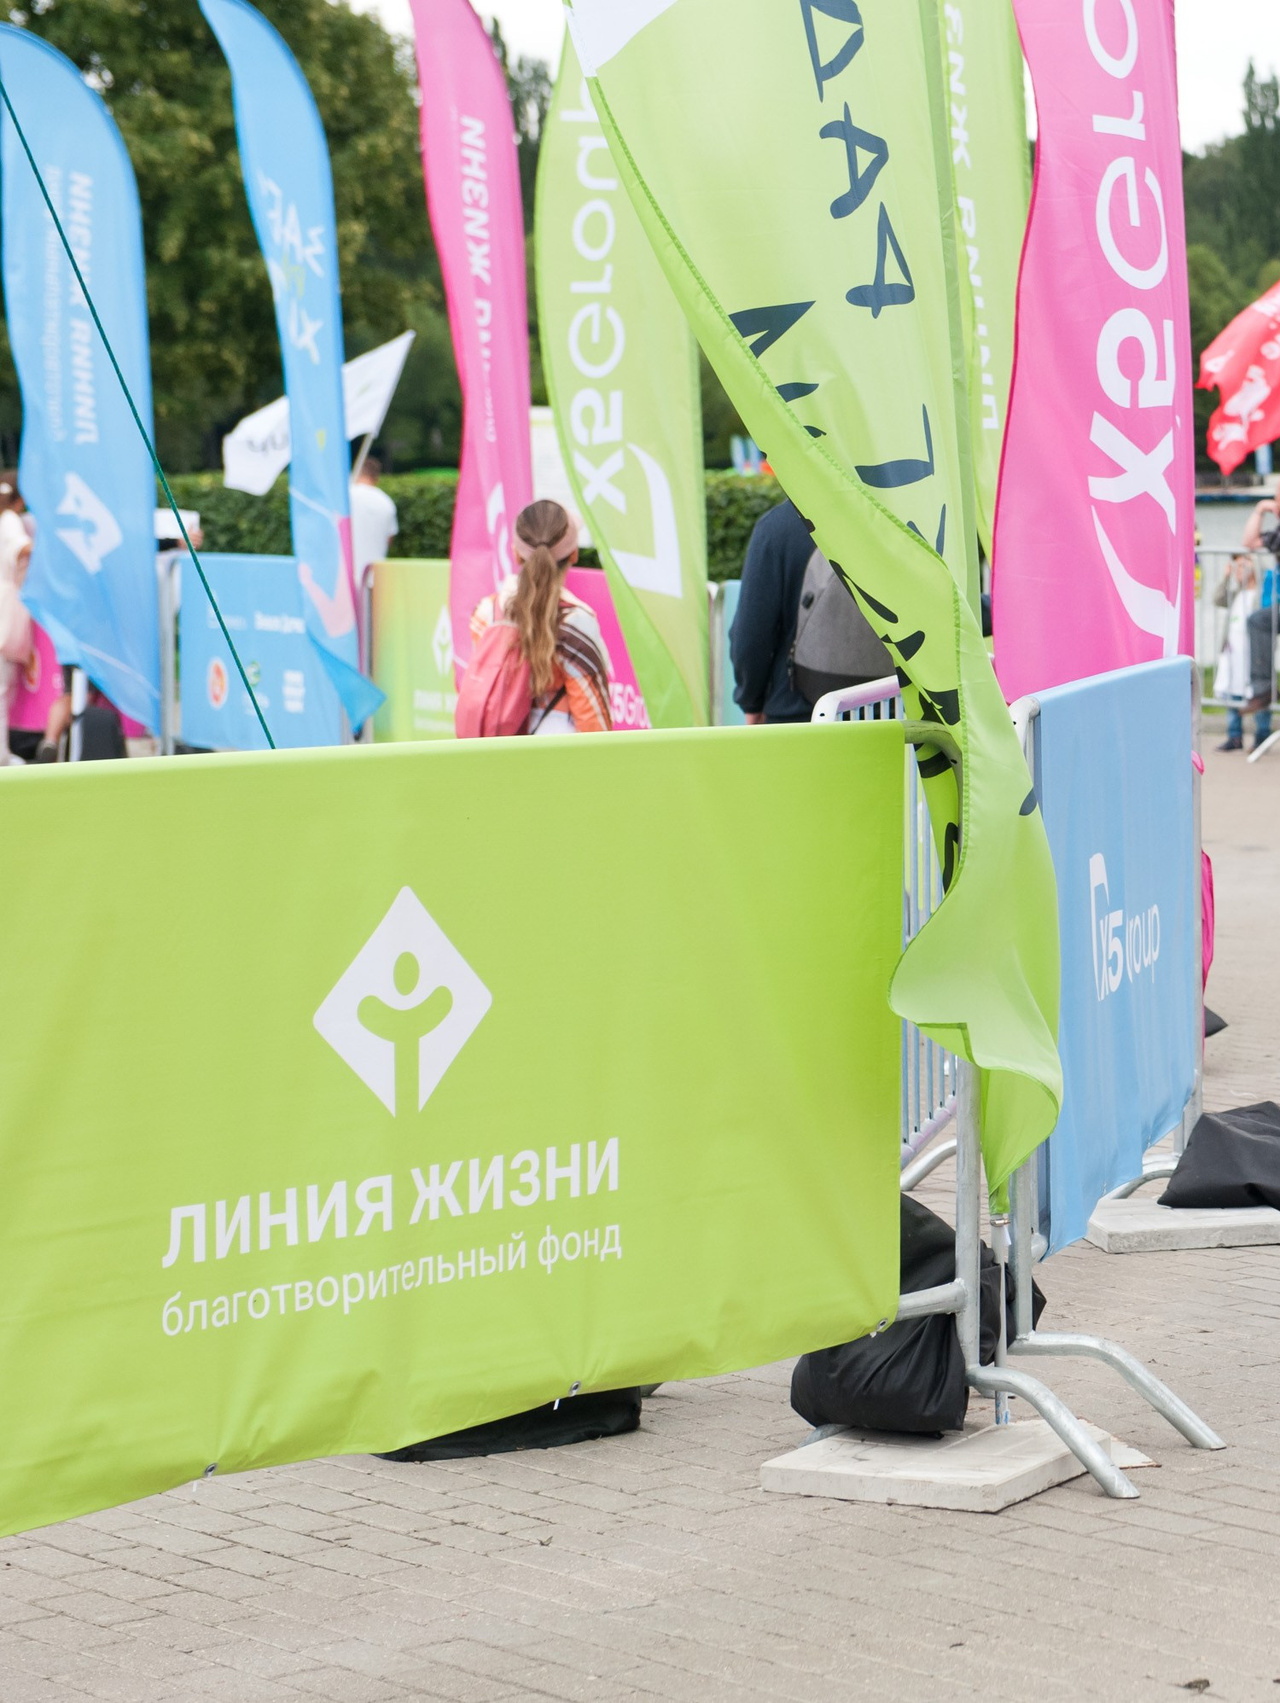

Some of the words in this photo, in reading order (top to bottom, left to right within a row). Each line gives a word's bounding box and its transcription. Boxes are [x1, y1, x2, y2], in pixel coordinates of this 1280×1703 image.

[162, 1173, 393, 1269] ЛИНИЯ
[409, 1136, 621, 1227] ЖИЗНИ
[161, 1233, 527, 1338] благотворительный
[537, 1219, 623, 1275] фонд
